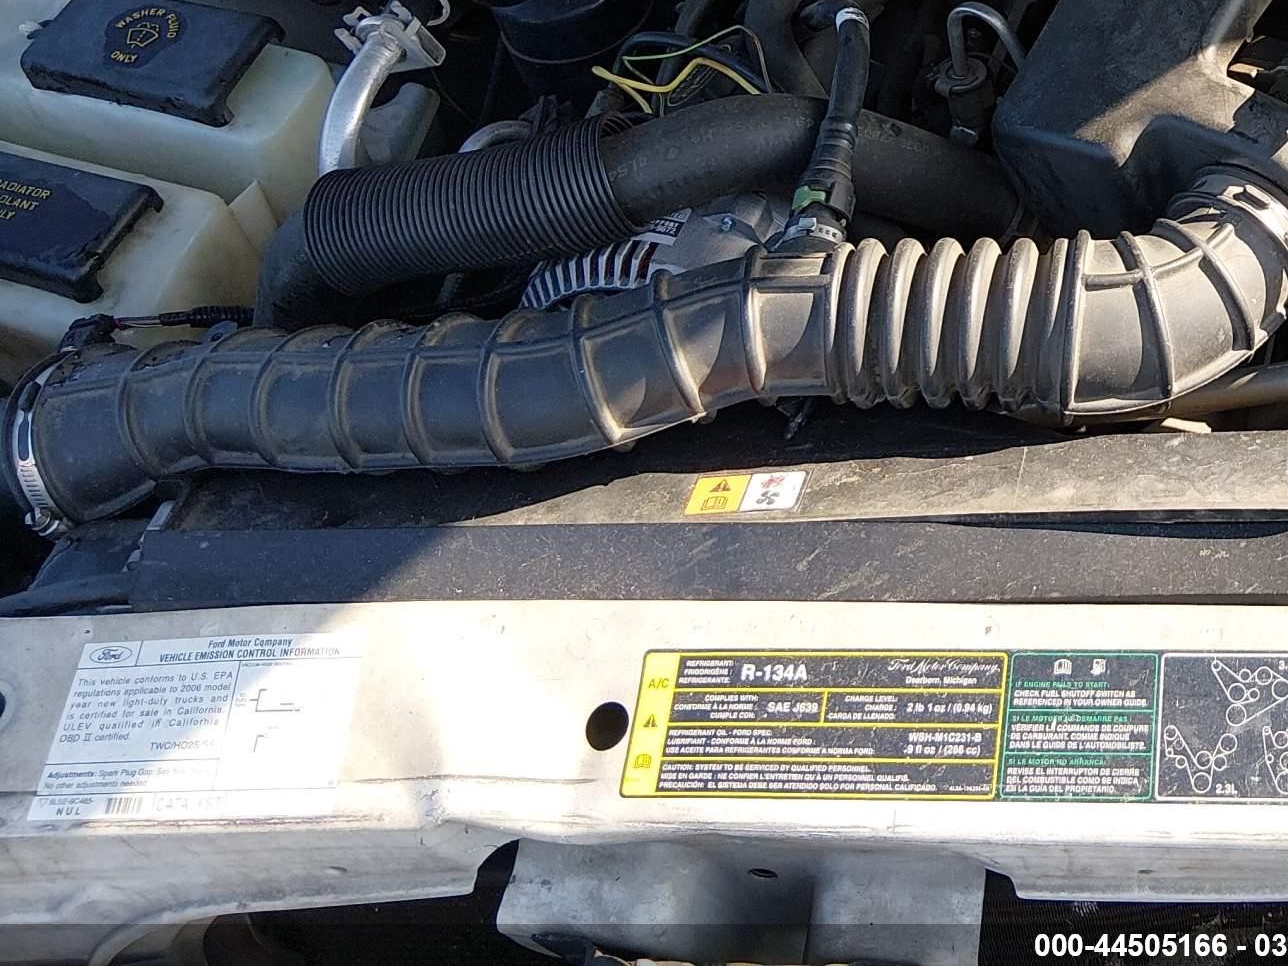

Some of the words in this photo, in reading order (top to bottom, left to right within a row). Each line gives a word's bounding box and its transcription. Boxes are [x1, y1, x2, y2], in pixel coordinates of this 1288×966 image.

[115, 8, 166, 28] WASHER
[166, 14, 178, 38] FLUID
[111, 51, 138, 62] ONLY
[208, 640, 224, 648] Ford
[228, 639, 251, 647] Motor
[254, 638, 293, 648] Company
[98, 649, 124, 661] Ford
[160, 652, 192, 662] VEHICLE
[195, 650, 233, 660] EMISSION
[237, 649, 276, 658] CONTROL
[280, 647, 340, 657] INFORMATION
[888, 659, 914, 671] Ford
[912, 660, 945, 673] Motor
[946, 659, 1000, 673] Company
[740, 663, 808, 681] R-134A
[101, 676, 130, 685] vehicle
[135, 674, 175, 684] conforms
[178, 674, 187, 682] to
[191, 672, 208, 681] U.S.
[214, 671, 233, 680] EPA
[648, 678, 669, 689] A/C
[943, 677, 977, 685] Michigan
[74, 688, 120, 698] regulations
[124, 686, 166, 696] applicable
[205, 683, 232, 691] model
[71, 701, 91, 710] year
[123, 696, 168, 707] light-duty
[176, 695, 204, 704] trucks
[211, 694, 229, 703] and
[767, 702, 790, 712] SAE
[792, 702, 818, 712] J639
[80, 710, 116, 720] certified
[123, 709, 135, 717] for
[140, 708, 159, 717] sale
[164, 707, 172, 715] in
[907, 704, 913, 712] 2
[914, 704, 924, 712] lb
[953, 703, 975, 713] (0.94
[977, 703, 992, 714] kg)
[64, 723, 91, 731] ULEV
[99, 720, 144, 731] qualified
[169, 718, 220, 726] California
[60, 735, 80, 743] OBD
[84, 734, 92, 742] II
[908, 733, 982, 742] WSH-M1C231-B
[907, 744, 913, 754] 9
[915, 745, 922, 754] fl
[966, 745, 980, 755] cc)
[47, 770, 96, 778] Adjustments:
[98, 769, 119, 778] Spark
[121, 769, 136, 777] Plug
[1215, 784, 1238, 794] 2.3L
